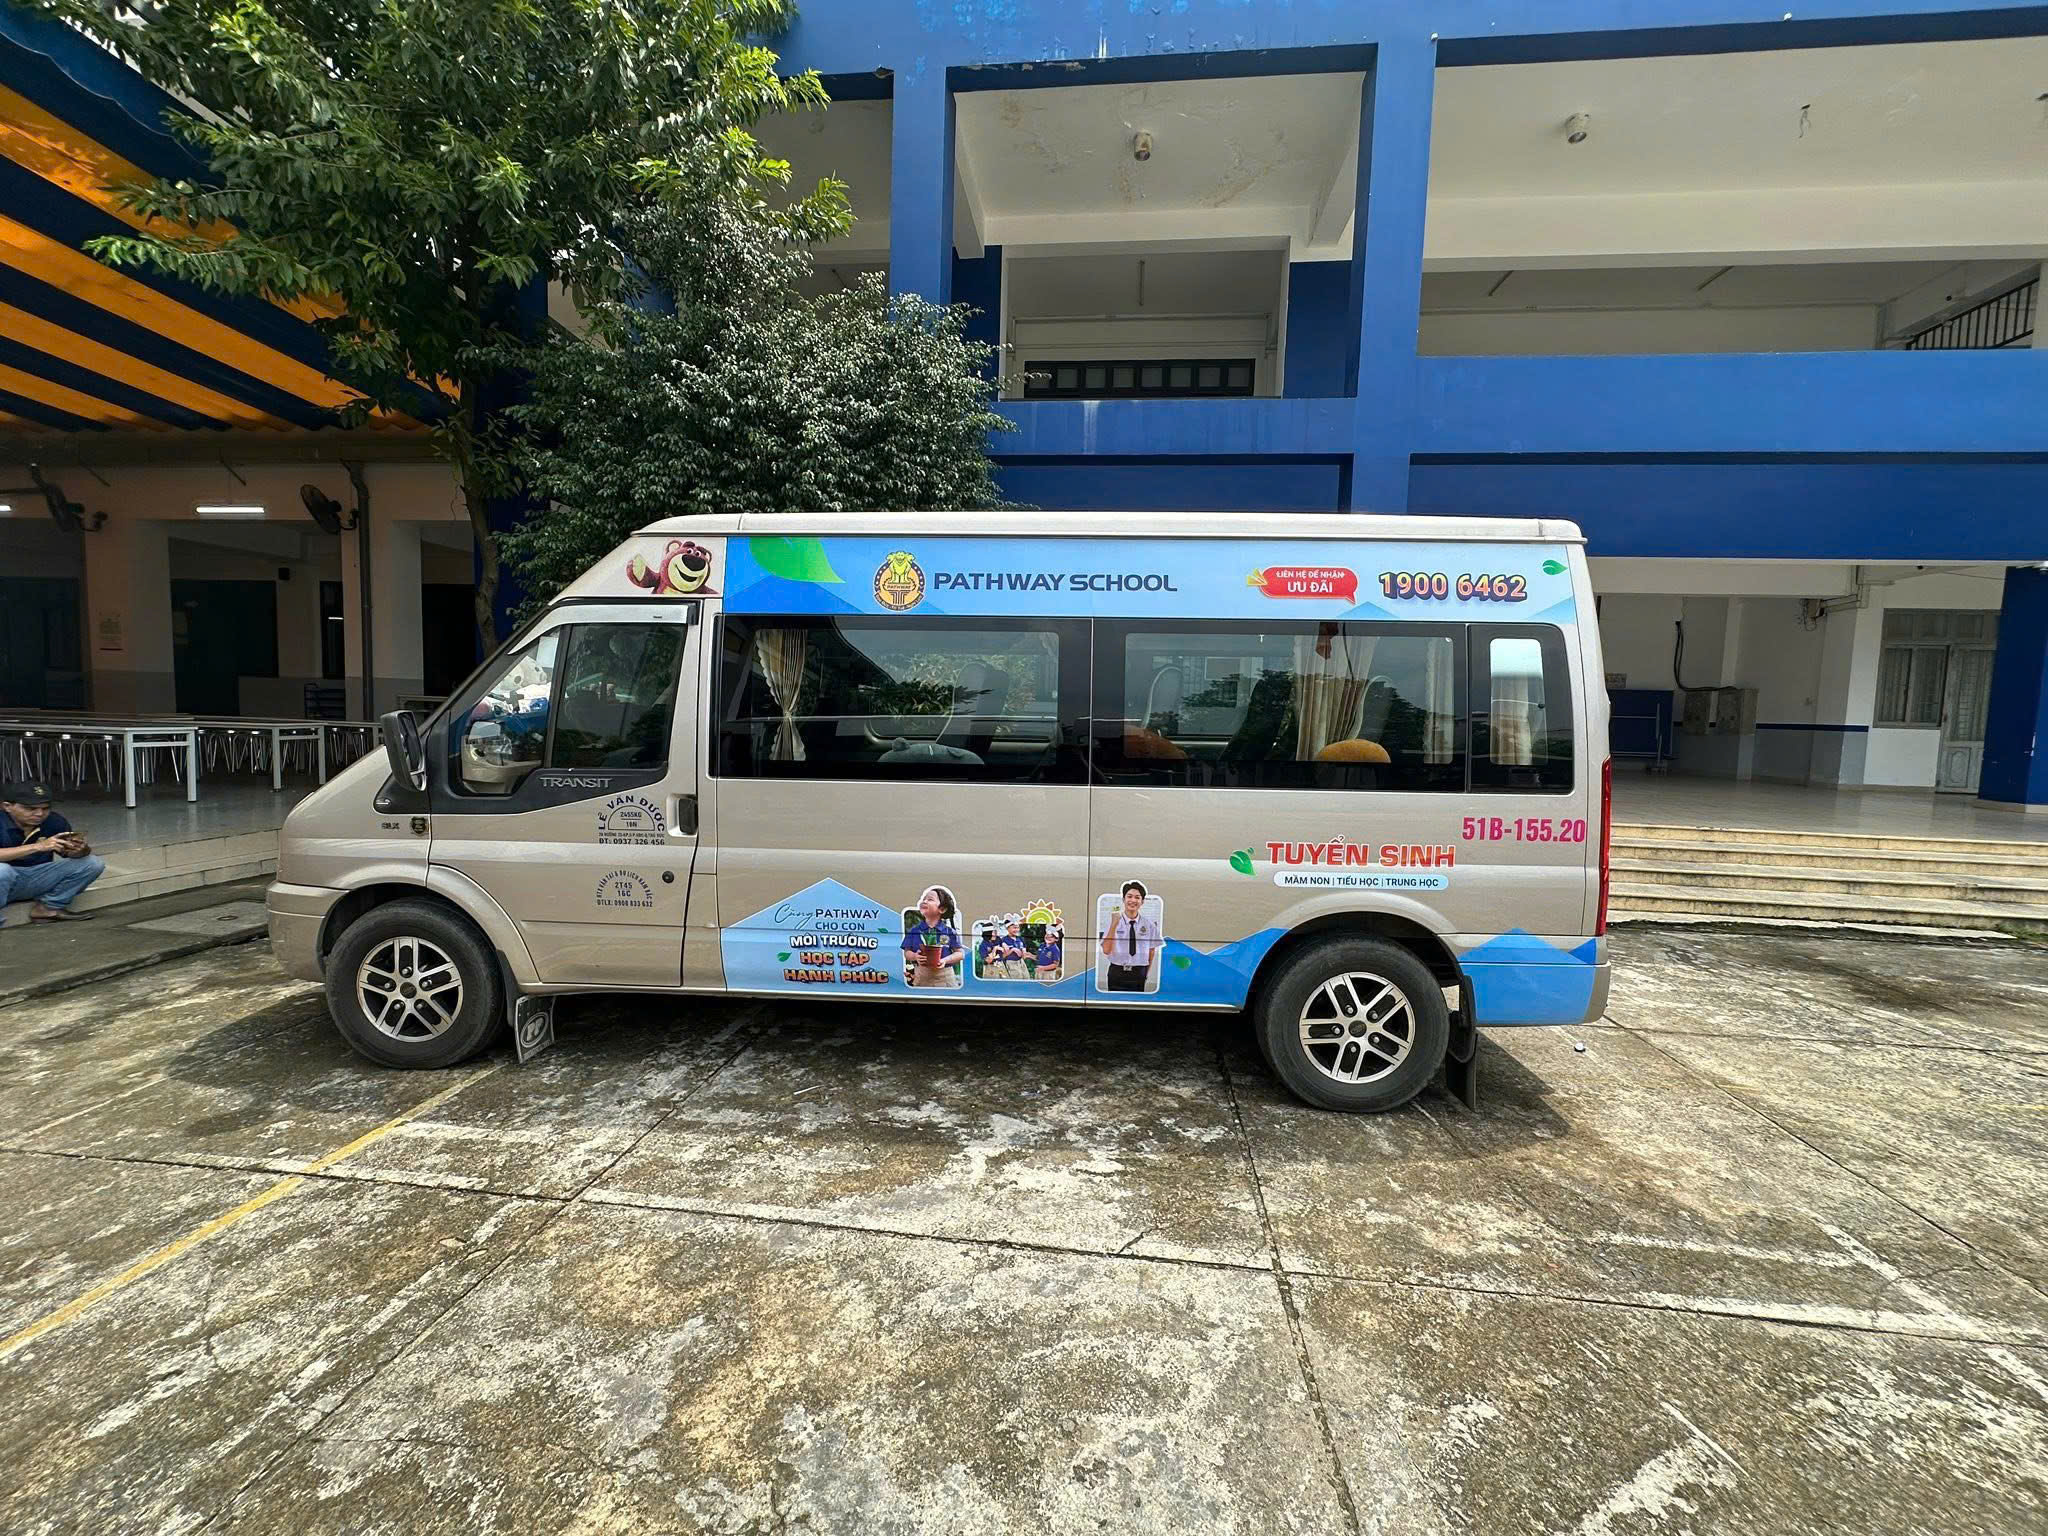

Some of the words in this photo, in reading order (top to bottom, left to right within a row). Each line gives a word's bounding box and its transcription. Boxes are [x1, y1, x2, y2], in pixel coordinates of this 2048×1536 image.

[933, 572, 1066, 591] PATHWAY
[1070, 573, 1178, 592] SCHOOL
[1287, 580, 1306, 593] ƯU
[1310, 579, 1333, 593] ĐÃI
[1379, 571, 1448, 599] 1900
[1457, 573, 1527, 602] 6462
[540, 777, 613, 788] TRANSIT
[639, 797, 665, 832] ĐƯỢC
[1462, 817, 1586, 842] 51B-155.20
[1266, 835, 1369, 867] TUYỂN
[1379, 843, 1456, 868] SINH
[615, 881, 633, 889] 2T45
[1284, 874, 1308, 885] MẦM
[1309, 876, 1330, 885] NON
[1359, 877, 1379, 888] HỌC
[1386, 878, 1417, 887] TRUNG
[1419, 878, 1439, 888] HỌC
[815, 908, 880, 919] PATHWAY
[815, 921, 839, 931] CHO
[841, 922, 865, 931] CON
[790, 932, 818, 949] MÔI
[800, 951, 834, 967] HỌC
[838, 950, 870, 967] TẬP
[783, 968, 836, 984] HẠNH
[840, 967, 889, 984] PHÚC
